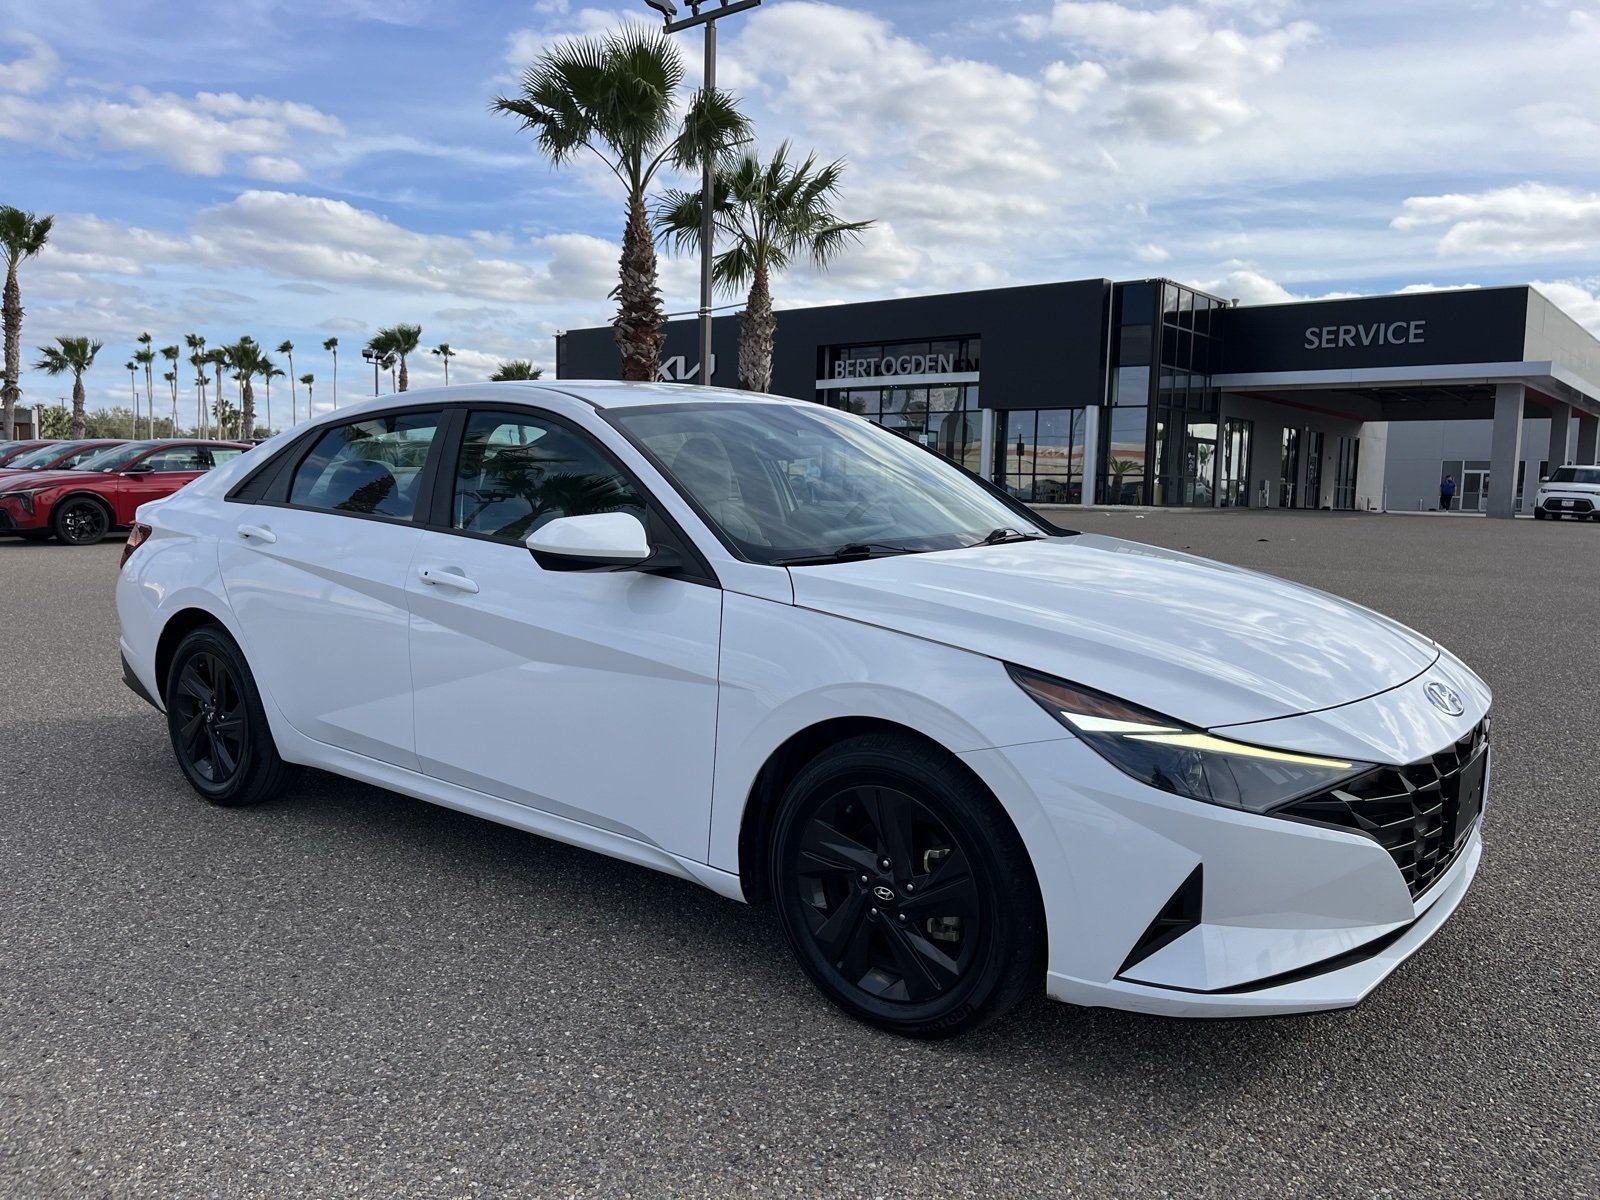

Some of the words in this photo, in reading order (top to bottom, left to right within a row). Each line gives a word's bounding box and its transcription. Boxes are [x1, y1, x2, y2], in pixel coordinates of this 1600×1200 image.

[1304, 320, 1426, 349] SERVICE
[834, 357, 879, 379] BERT
[880, 353, 954, 376] OGDEN
